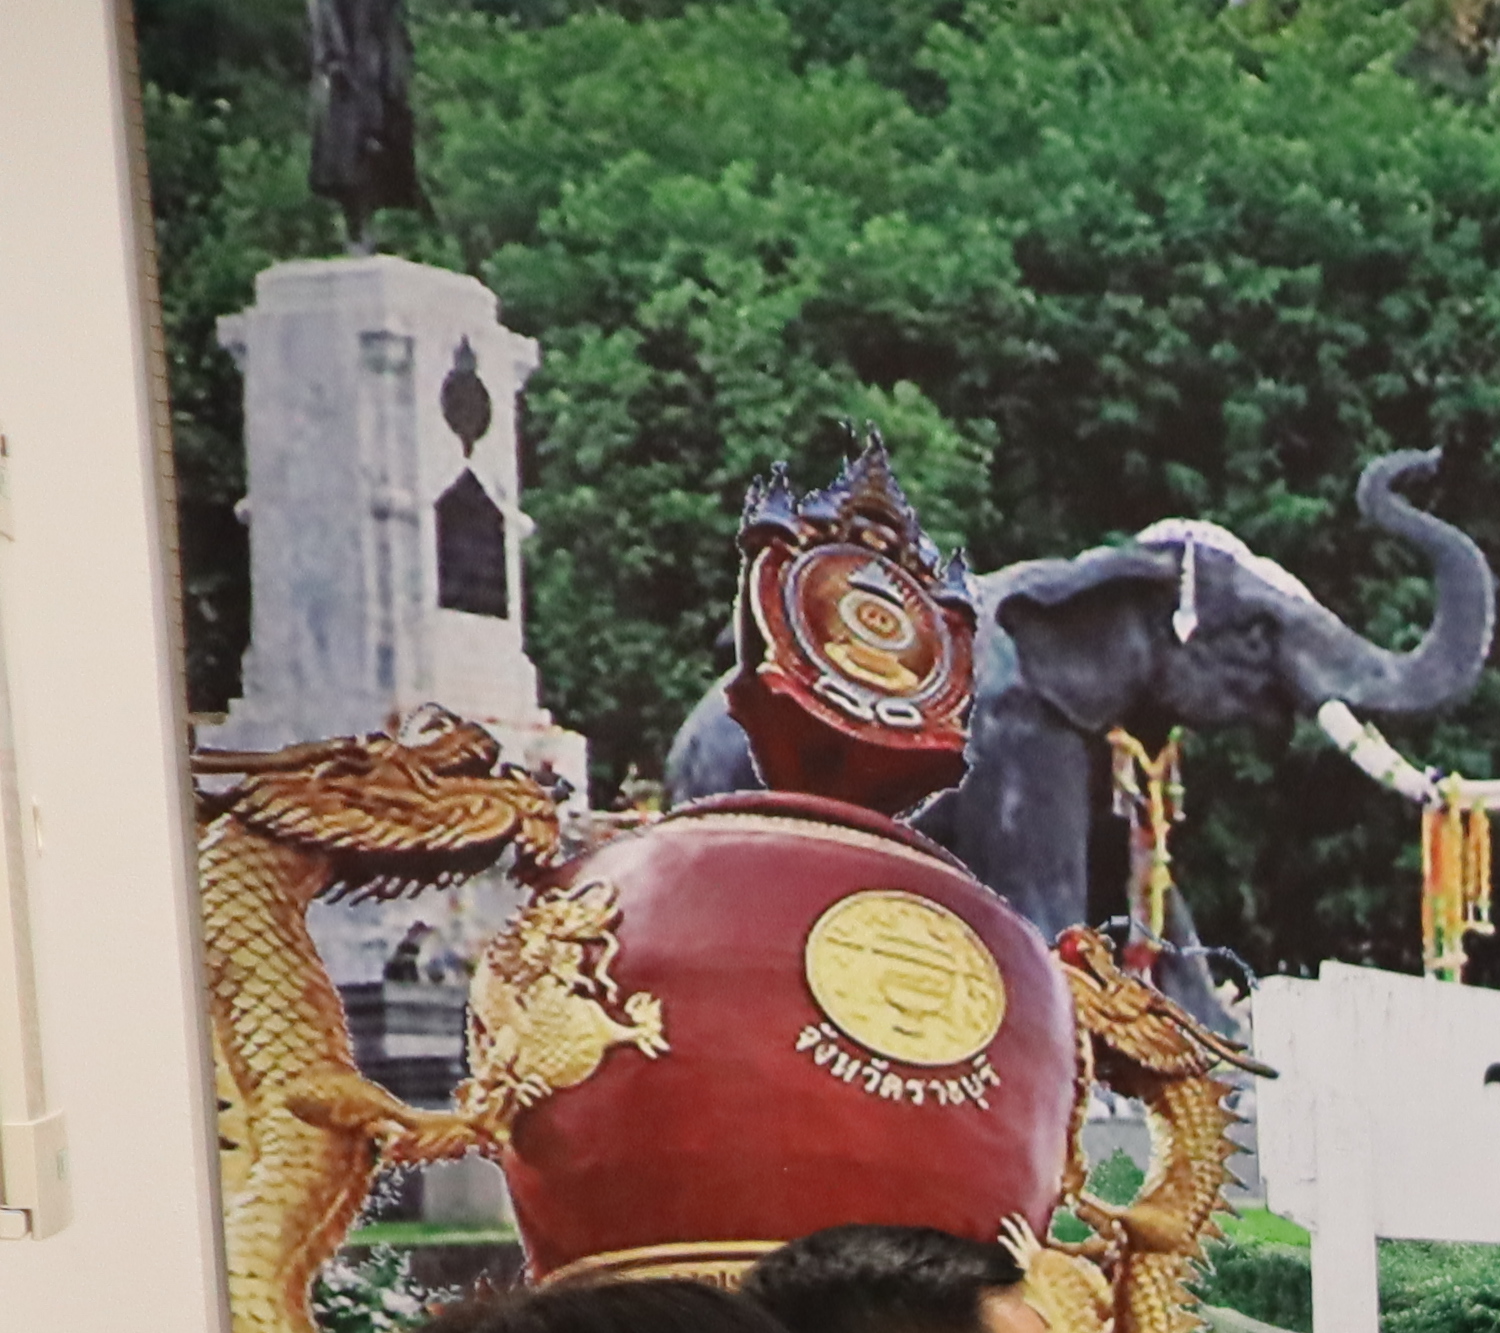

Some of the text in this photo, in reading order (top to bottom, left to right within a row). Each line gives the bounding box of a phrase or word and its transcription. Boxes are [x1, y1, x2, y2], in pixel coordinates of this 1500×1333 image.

[795, 1022, 1001, 1110] จังหวัดราชบุรี
